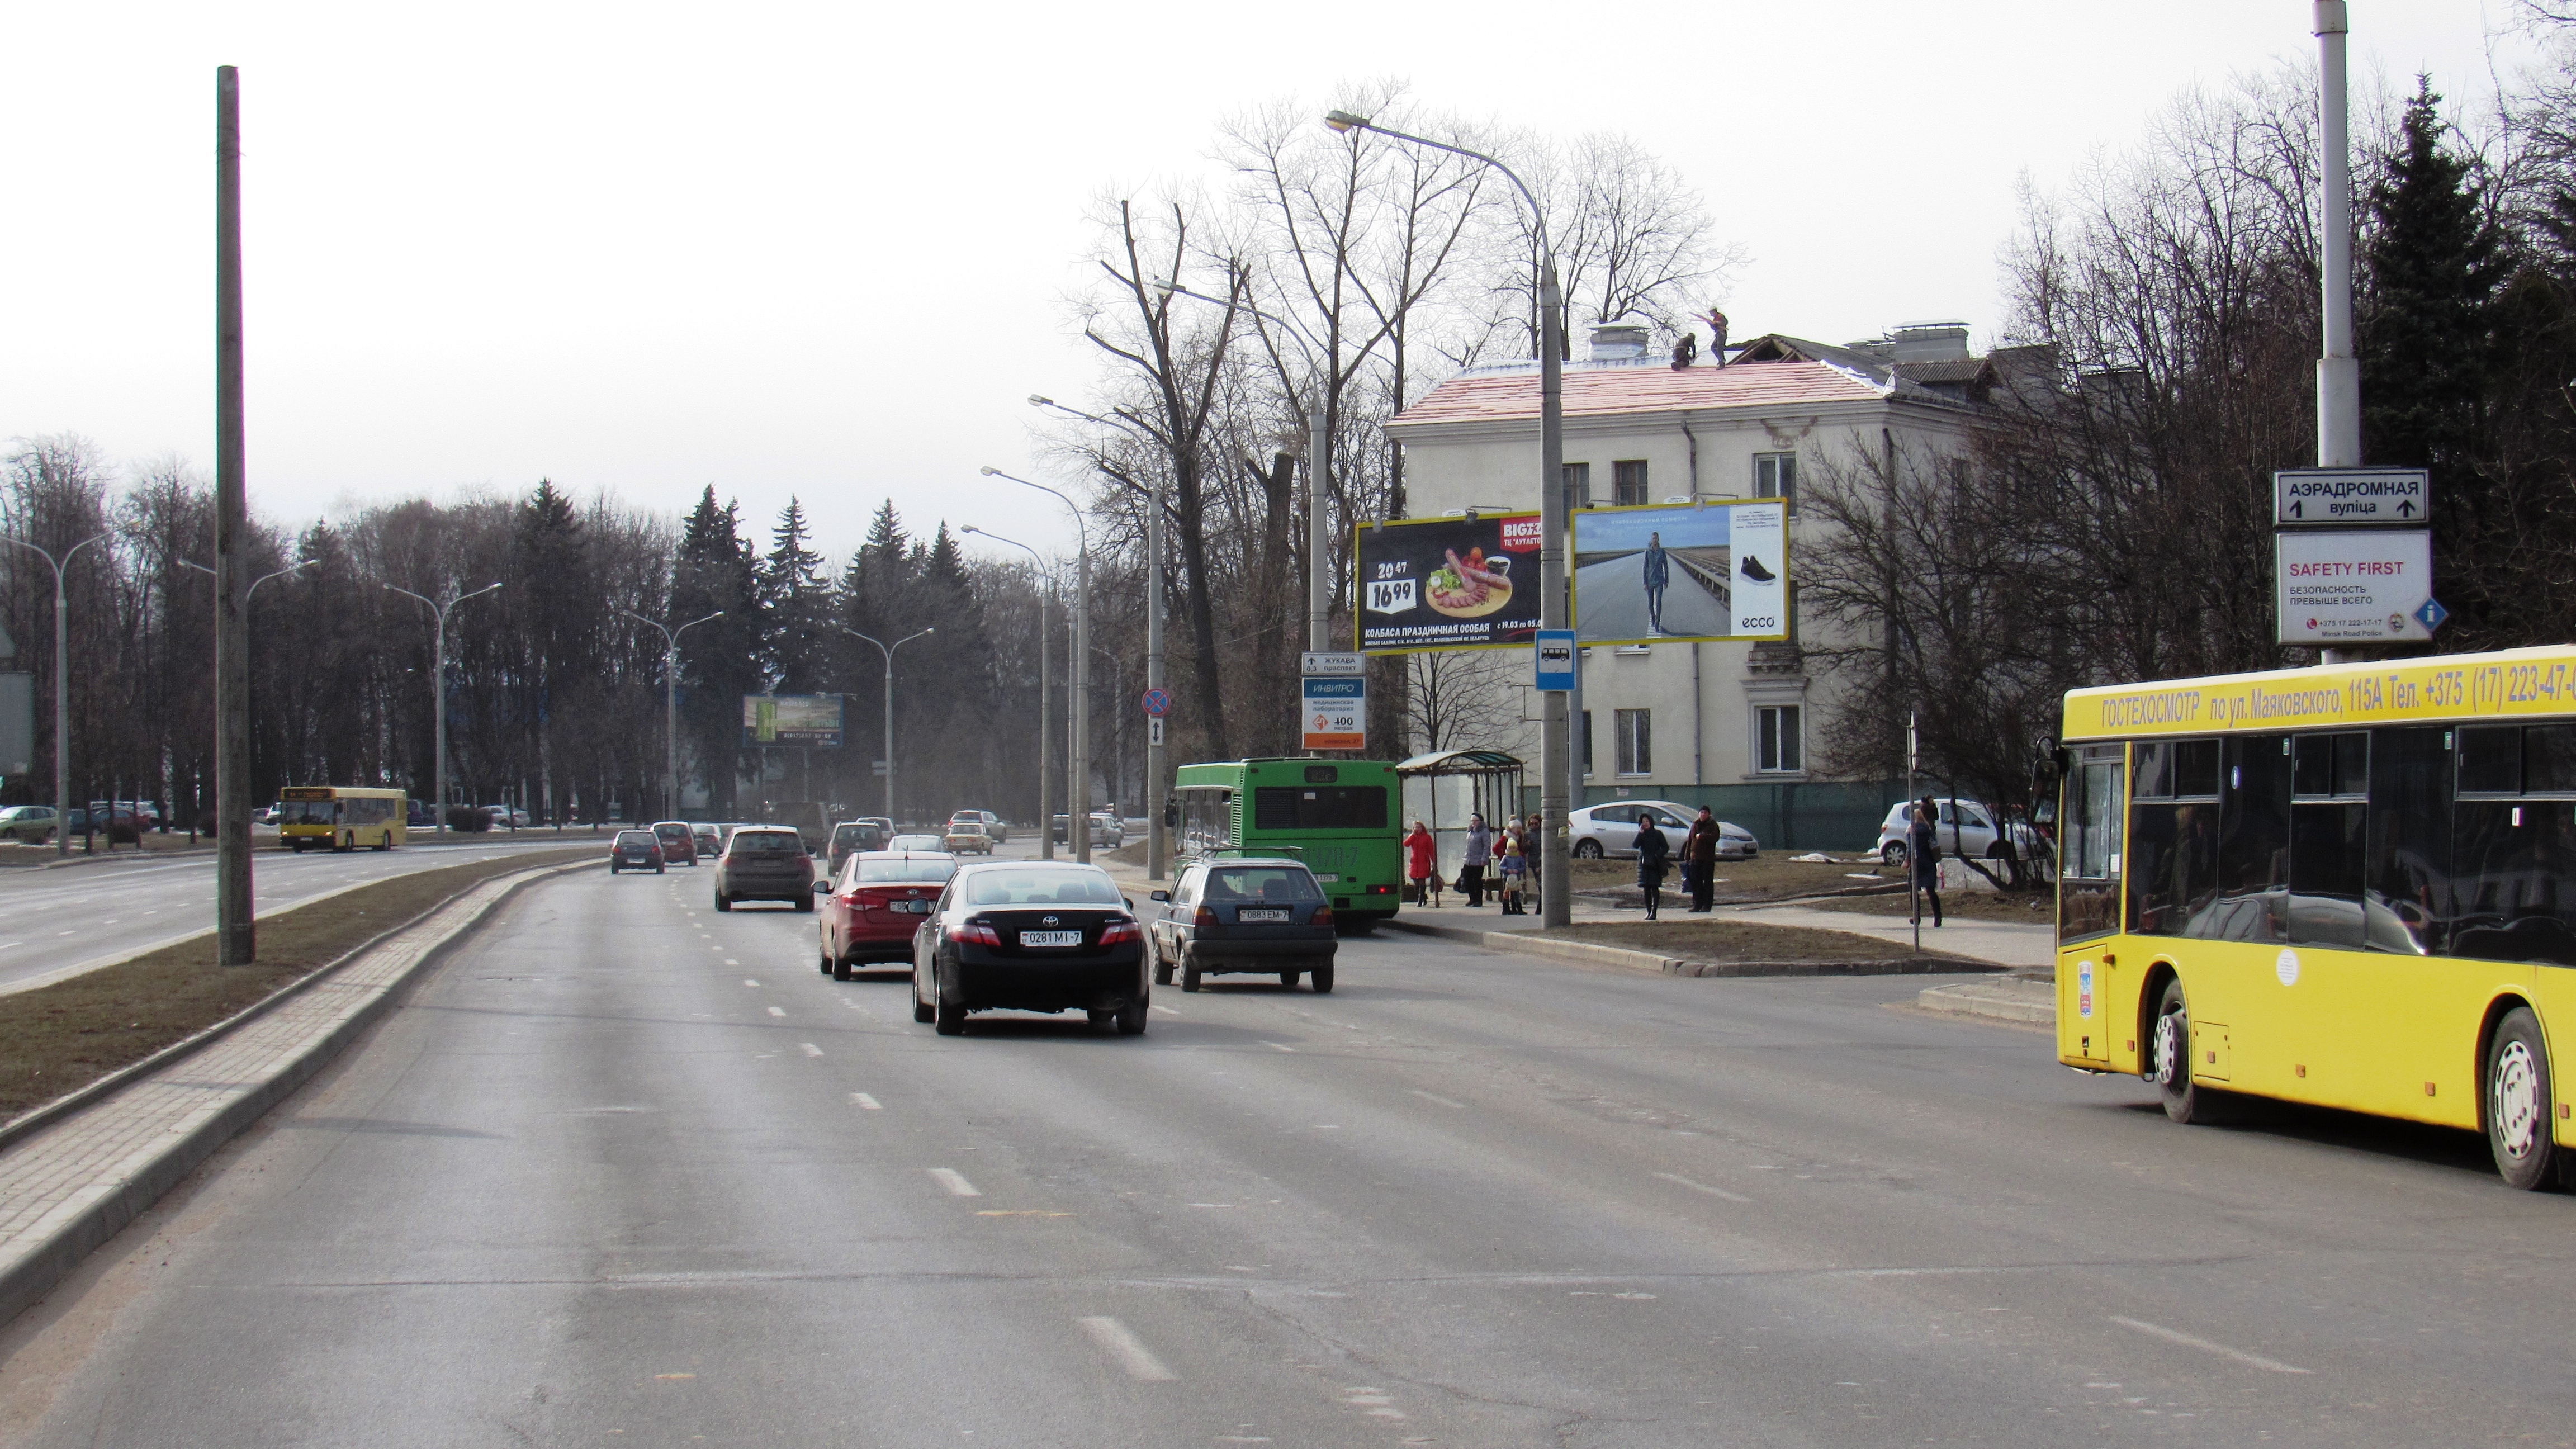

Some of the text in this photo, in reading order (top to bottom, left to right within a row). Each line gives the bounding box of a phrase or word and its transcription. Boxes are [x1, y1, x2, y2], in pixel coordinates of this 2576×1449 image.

[2289, 482, 2419, 498] АЭРАДРОМНАЯ
[2330, 500, 2376, 515] вуліца
[2289, 562, 2403, 576] SAFETY FIRST
[2290, 586, 2366, 594] БЕЗОПАСНОСТЬ
[1365, 623, 1490, 638] КОЛБАСА ПРАЗДНИЧНАЯ ОСОБАЯ
[1502, 621, 1518, 629] 19.03
[1527, 619, 1541, 627] 05.0
[2102, 690, 2200, 727] ГОСТЕХОСМОТР
[2210, 698, 2225, 719] по
[2228, 697, 2247, 727] ул.
[2251, 688, 2343, 719] Маяковского,
[2388, 675, 2419, 708] Тел.
[2426, 671, 2463, 706] +375
[2473, 666, 2502, 712] (17)
[1030, 932, 1052, 943] 0281
